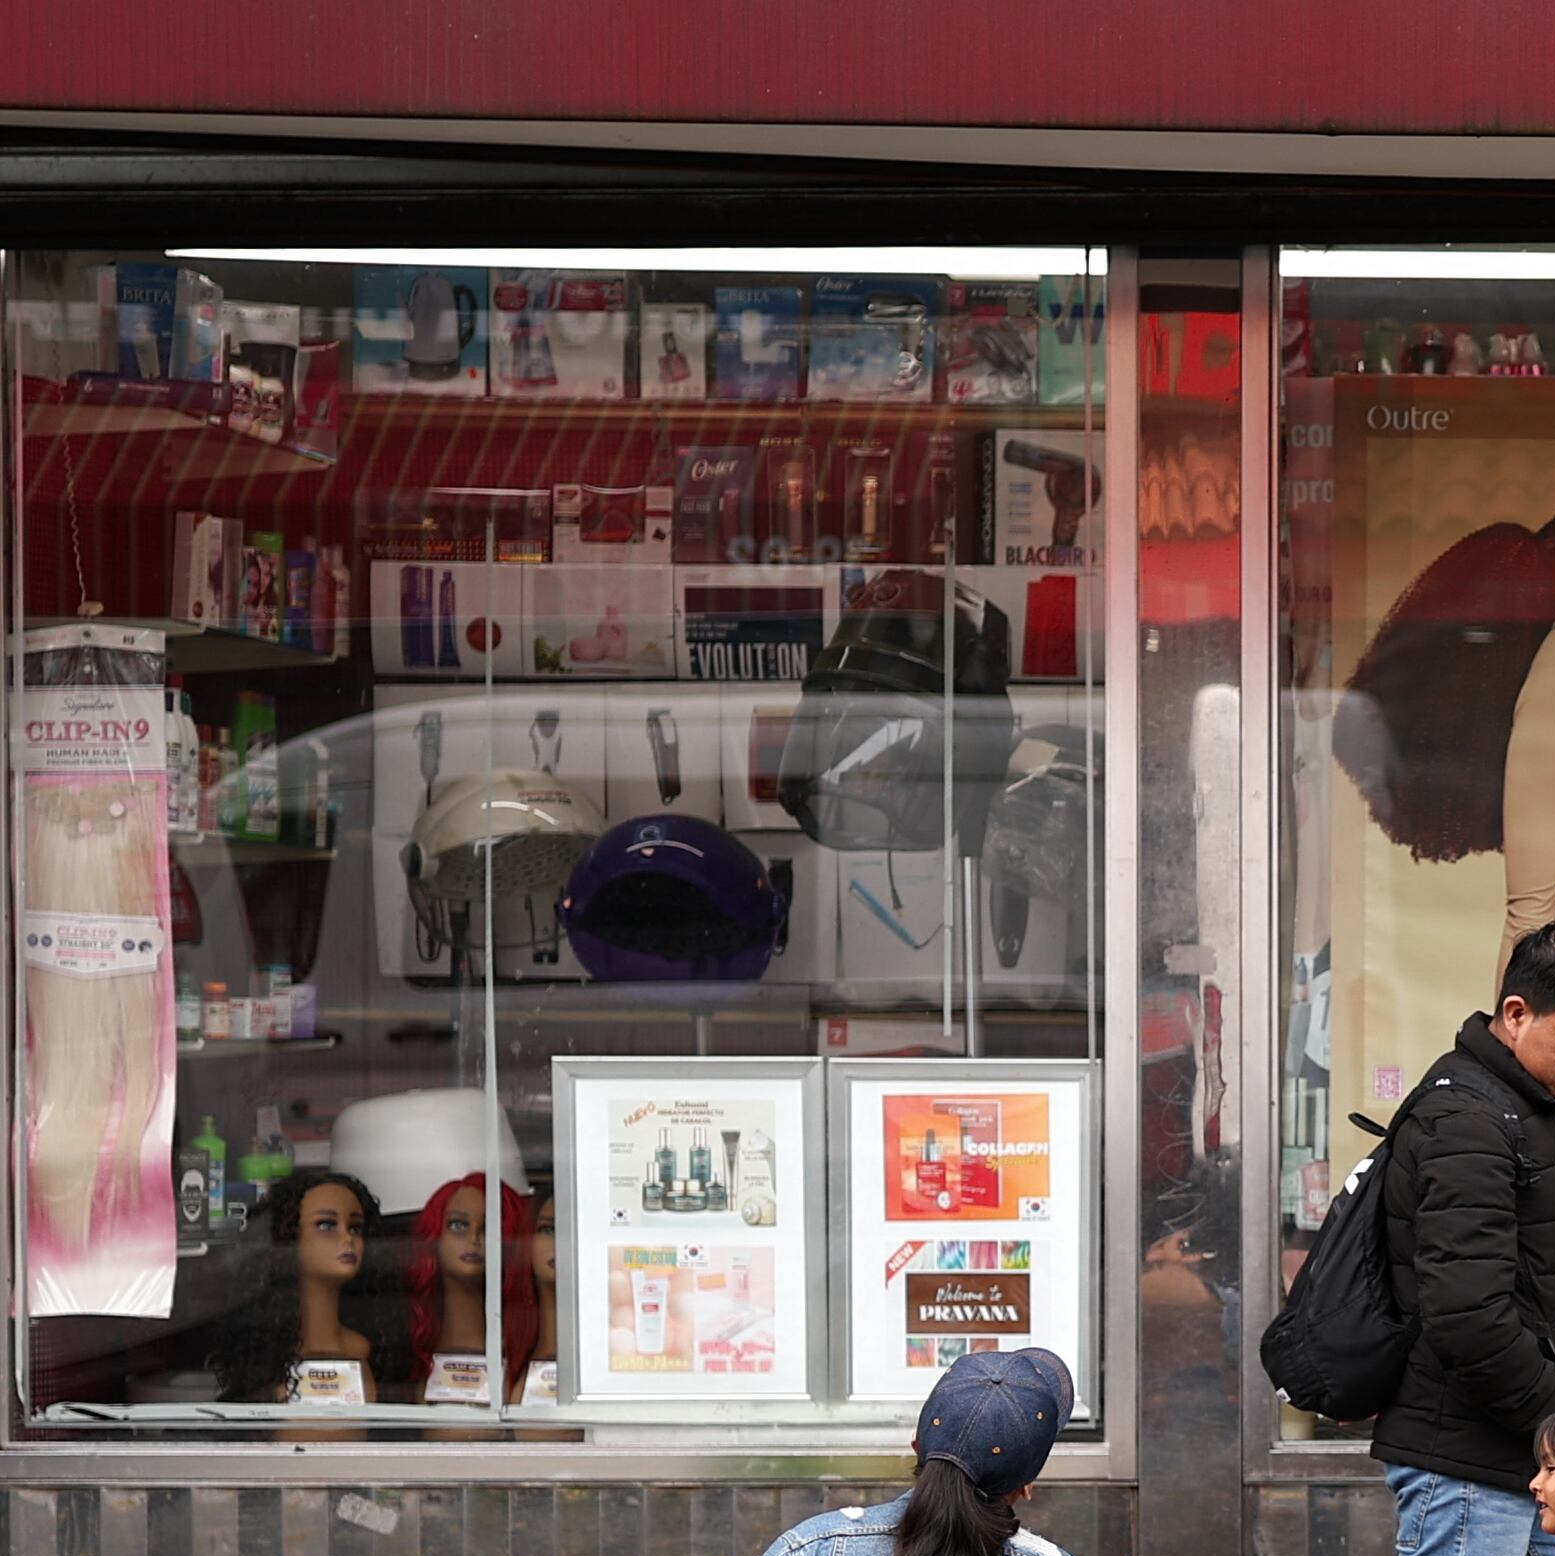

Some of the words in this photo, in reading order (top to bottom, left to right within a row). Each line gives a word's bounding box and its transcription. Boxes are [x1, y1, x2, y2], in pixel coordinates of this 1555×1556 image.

[122, 285, 171, 304] BRITA
[1367, 405, 1450, 431] Outre
[691, 458, 738, 481] Oster
[25, 720, 129, 743] CLIP-IN
[133, 718, 149, 742] 9
[887, 1243, 915, 1273] NEW
[936, 1283, 985, 1303] Welcome
[989, 1284, 1003, 1301] to
[918, 1305, 1019, 1322] PRAVANA
